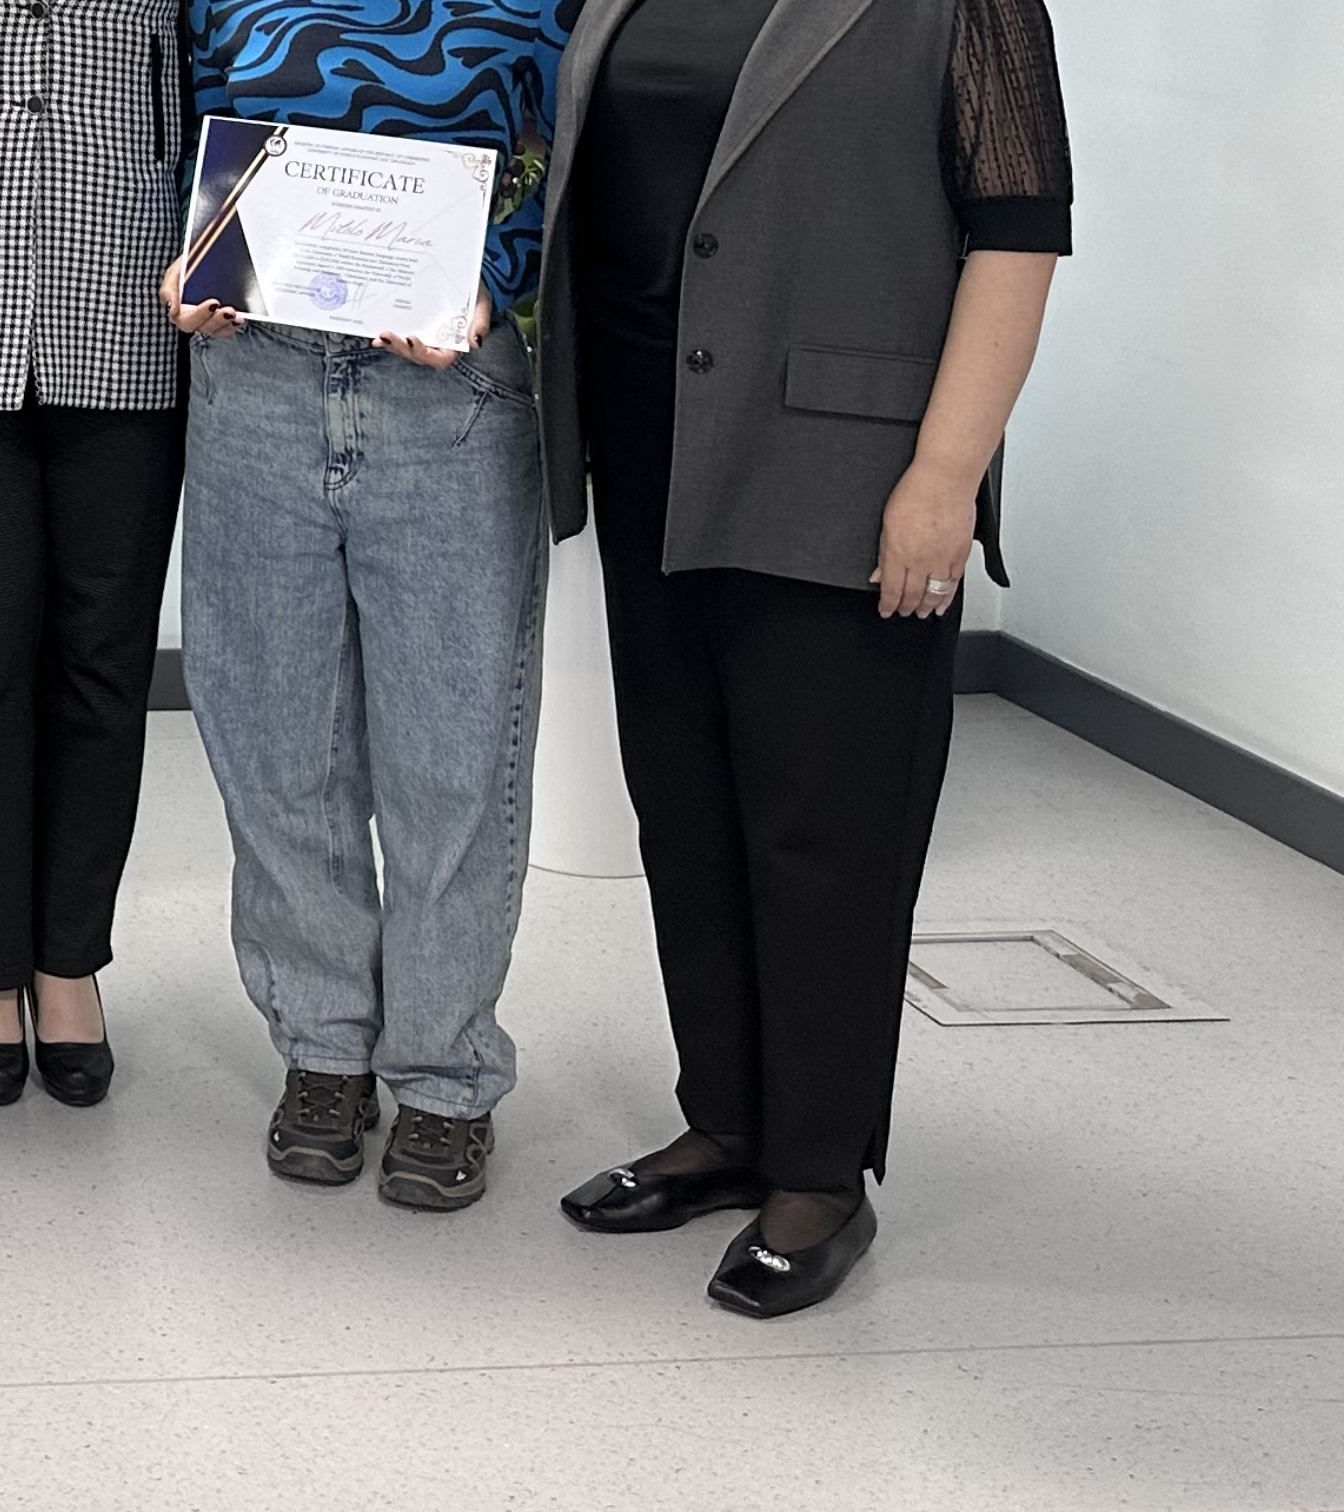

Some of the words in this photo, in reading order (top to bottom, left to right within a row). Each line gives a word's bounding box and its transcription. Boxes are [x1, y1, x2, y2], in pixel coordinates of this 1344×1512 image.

[284, 160, 425, 194] CERTIFICATE
[317, 186, 330, 196] OF
[332, 188, 399, 205] GRADUATION
